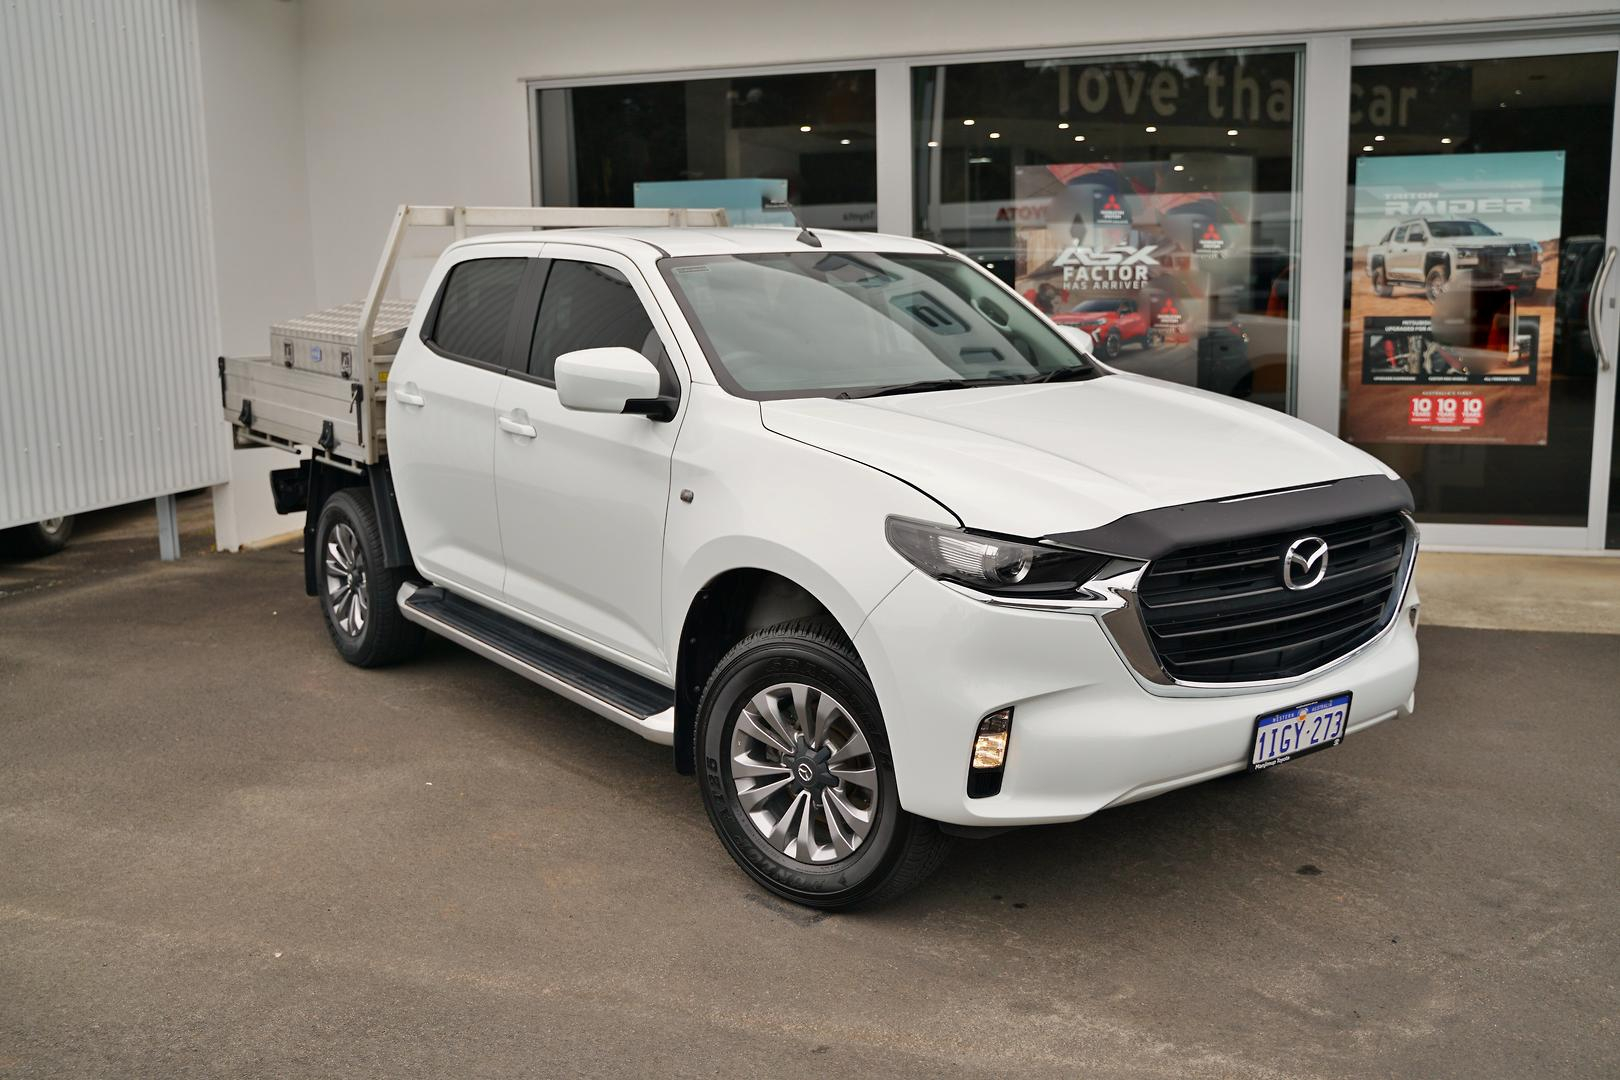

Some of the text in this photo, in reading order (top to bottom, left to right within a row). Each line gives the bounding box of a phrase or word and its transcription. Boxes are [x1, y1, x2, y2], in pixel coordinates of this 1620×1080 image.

[1058, 64, 1179, 117] love
[1204, 62, 1291, 121] tha
[1384, 192, 1439, 200] TRITON
[1384, 199, 1532, 216] RAIDER
[1063, 265, 1149, 281] FACTOR
[1063, 281, 1088, 290] HAS
[1412, 398, 1482, 413] 10 10 10
